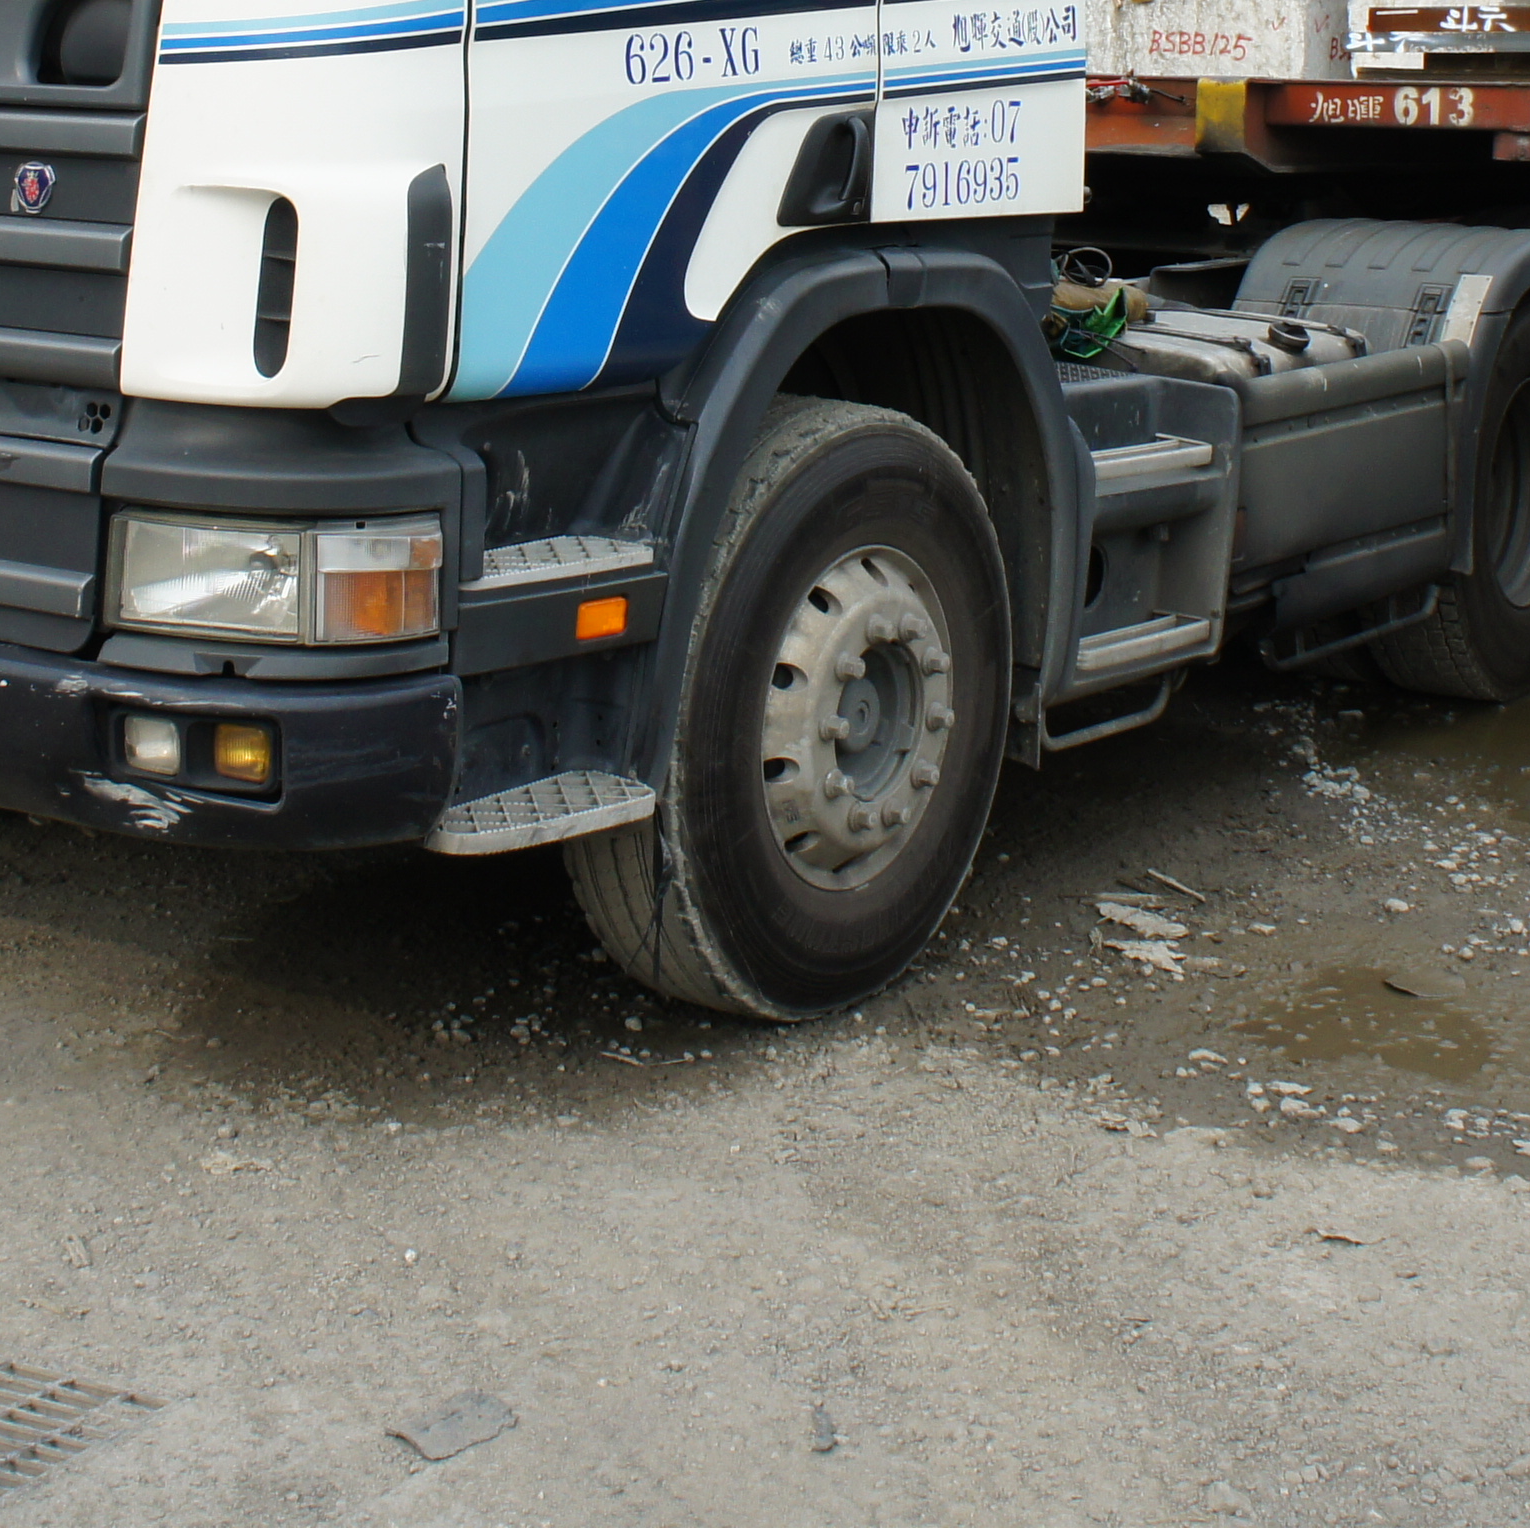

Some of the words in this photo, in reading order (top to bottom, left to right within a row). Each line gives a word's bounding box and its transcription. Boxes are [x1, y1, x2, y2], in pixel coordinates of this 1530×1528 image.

[625, 26, 760, 85] 626-XG
[1149, 30, 1252, 60] BSBB125
[1309, 91, 1384, 123] 旭暉
[1394, 87, 1474, 126] 613
[905, 157, 1019, 210] 7916935
